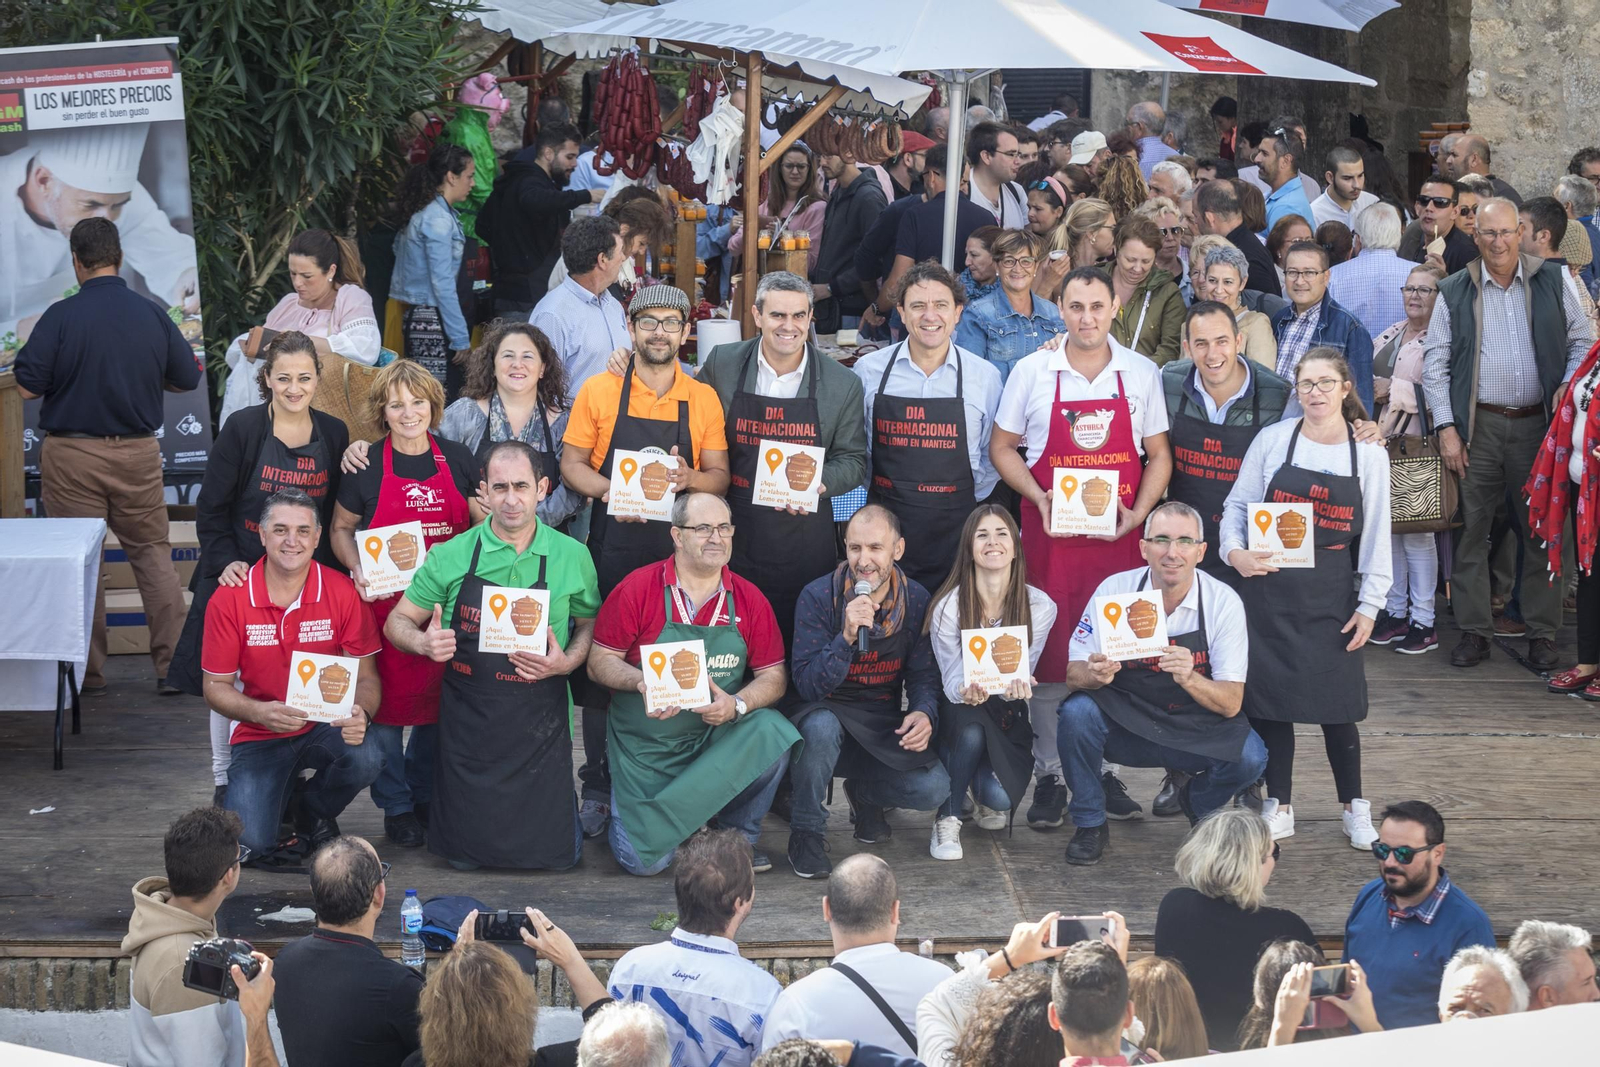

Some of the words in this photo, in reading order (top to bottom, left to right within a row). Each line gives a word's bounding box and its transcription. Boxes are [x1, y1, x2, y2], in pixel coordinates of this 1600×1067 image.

[16, 74, 24, 84] de
[25, 73, 35, 83] los
[36, 71, 76, 83] profesionales
[77, 71, 86, 80] de
[86, 70, 93, 79] la
[128, 70, 133, 78] y
[133, 68, 140, 76] el
[140, 65, 169, 75] COMERCIO
[34, 92, 58, 111] LOS
[61, 88, 117, 109] MEJORES
[119, 84, 173, 105] PRECIOS
[62, 110, 74, 121] sin
[75, 109, 99, 122] perder
[100, 108, 108, 118] el
[109, 108, 128, 118] buen
[129, 106, 150, 118] gusto
[765, 406, 784, 420] DIA
[906, 406, 926, 420] DIA
[736, 418, 817, 437] INTERNACIONAL
[876, 418, 959, 437] INTERNACIONAL
[736, 434, 748, 444] DEL
[888, 436, 909, 447] LOMO
[910, 438, 920, 448] EN
[921, 439, 957, 449] MANTECA
[1203, 437, 1222, 453] DIA
[175, 450, 195, 458] PRECIOS
[1049, 453, 1062, 467] DÍA
[1063, 451, 1131, 467] INTERNACIONAL
[174, 456, 208, 464] COMPETITIVOS
[297, 457, 316, 471] DIA
[1185, 464, 1204, 477] LOMO
[1205, 469, 1215, 479] EN
[260, 481, 273, 493] DEL
[767, 487, 790, 496] elabora
[917, 483, 957, 494] Cruzcampo
[1309, 484, 1329, 500] DIA
[405, 500, 430, 508] LUISA
[622, 497, 645, 506] elabora
[1318, 518, 1351, 532] MANTECA
[428, 526, 453, 537] MANTECA
[371, 583, 389, 592] Lomo
[493, 634, 517, 642] elabora
[512, 642, 541, 651] Manteca!
[1115, 641, 1138, 649] elabora
[1107, 649, 1125, 658] Lomo
[451, 661, 472, 676] VEJER
[859, 676, 868, 684] EN
[299, 701, 323, 709] elabora
[319, 709, 347, 719] Manteca!
